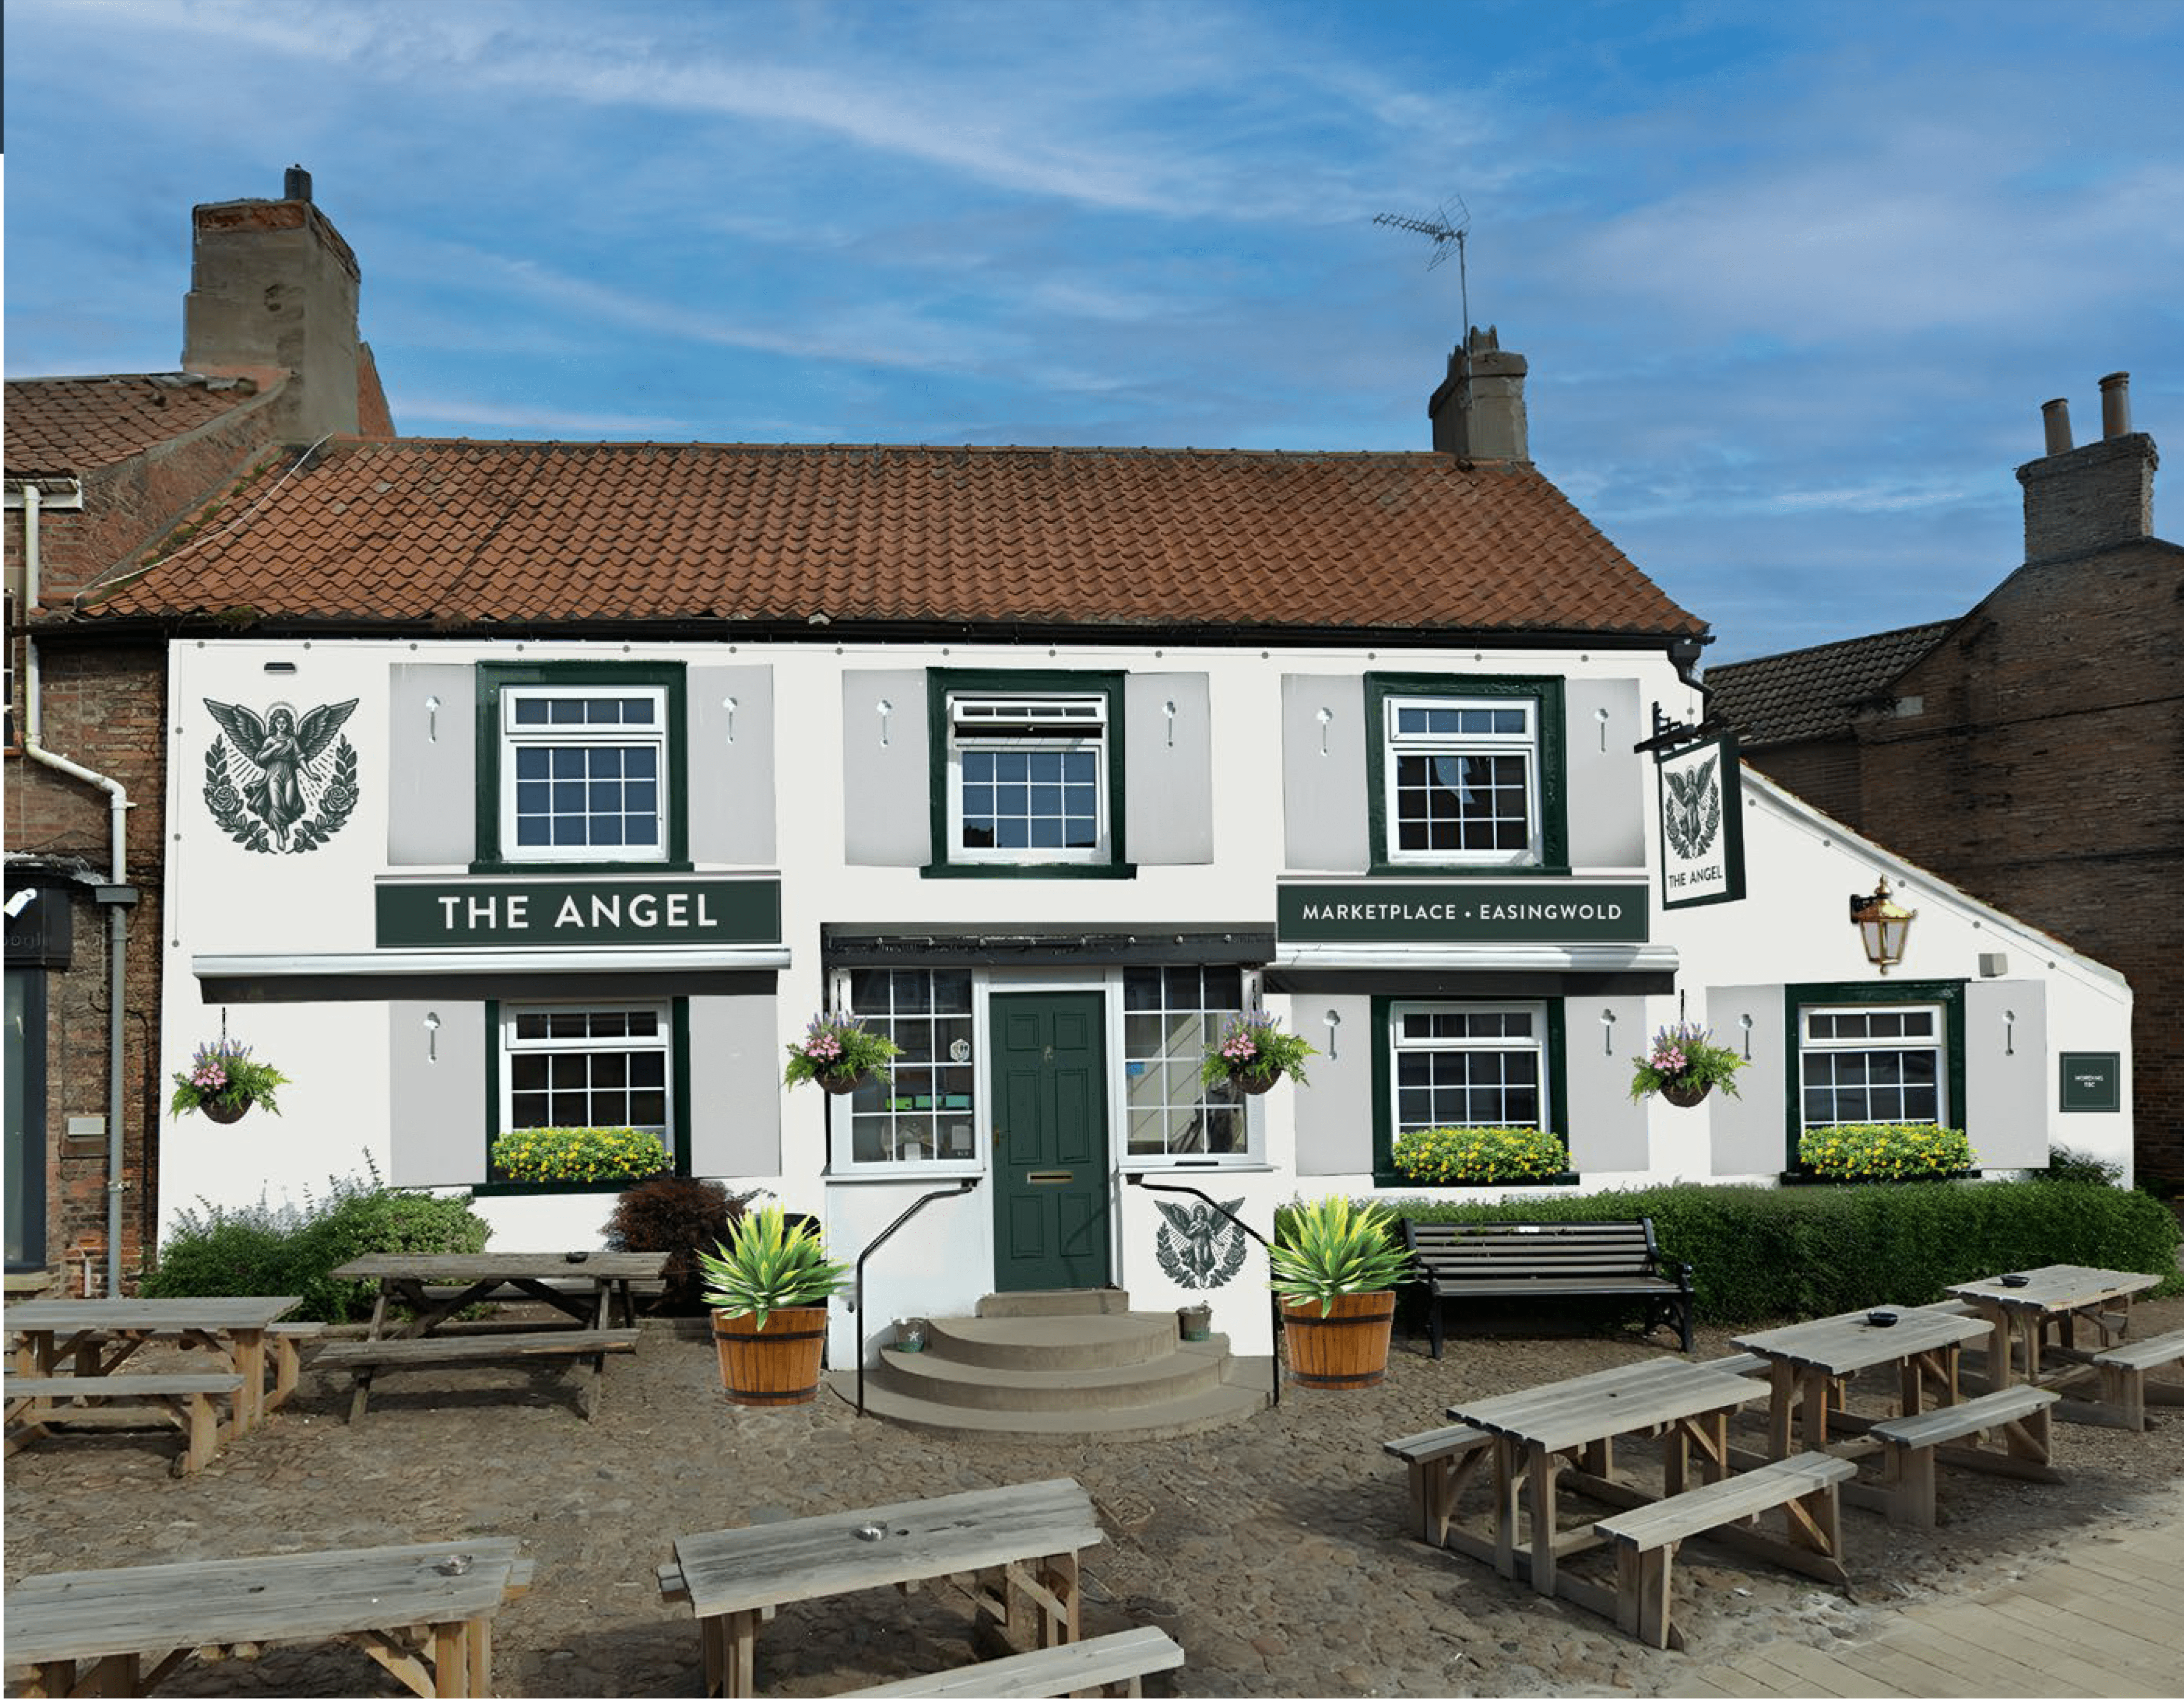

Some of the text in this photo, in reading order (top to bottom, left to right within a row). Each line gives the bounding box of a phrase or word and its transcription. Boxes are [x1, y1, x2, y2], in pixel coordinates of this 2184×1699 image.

[1669, 865, 1722, 888] THE ANGEL
[438, 893, 717, 929] THE ANGEL
[1302, 904, 1623, 920] MARKETPLACE EASINGWOLD
